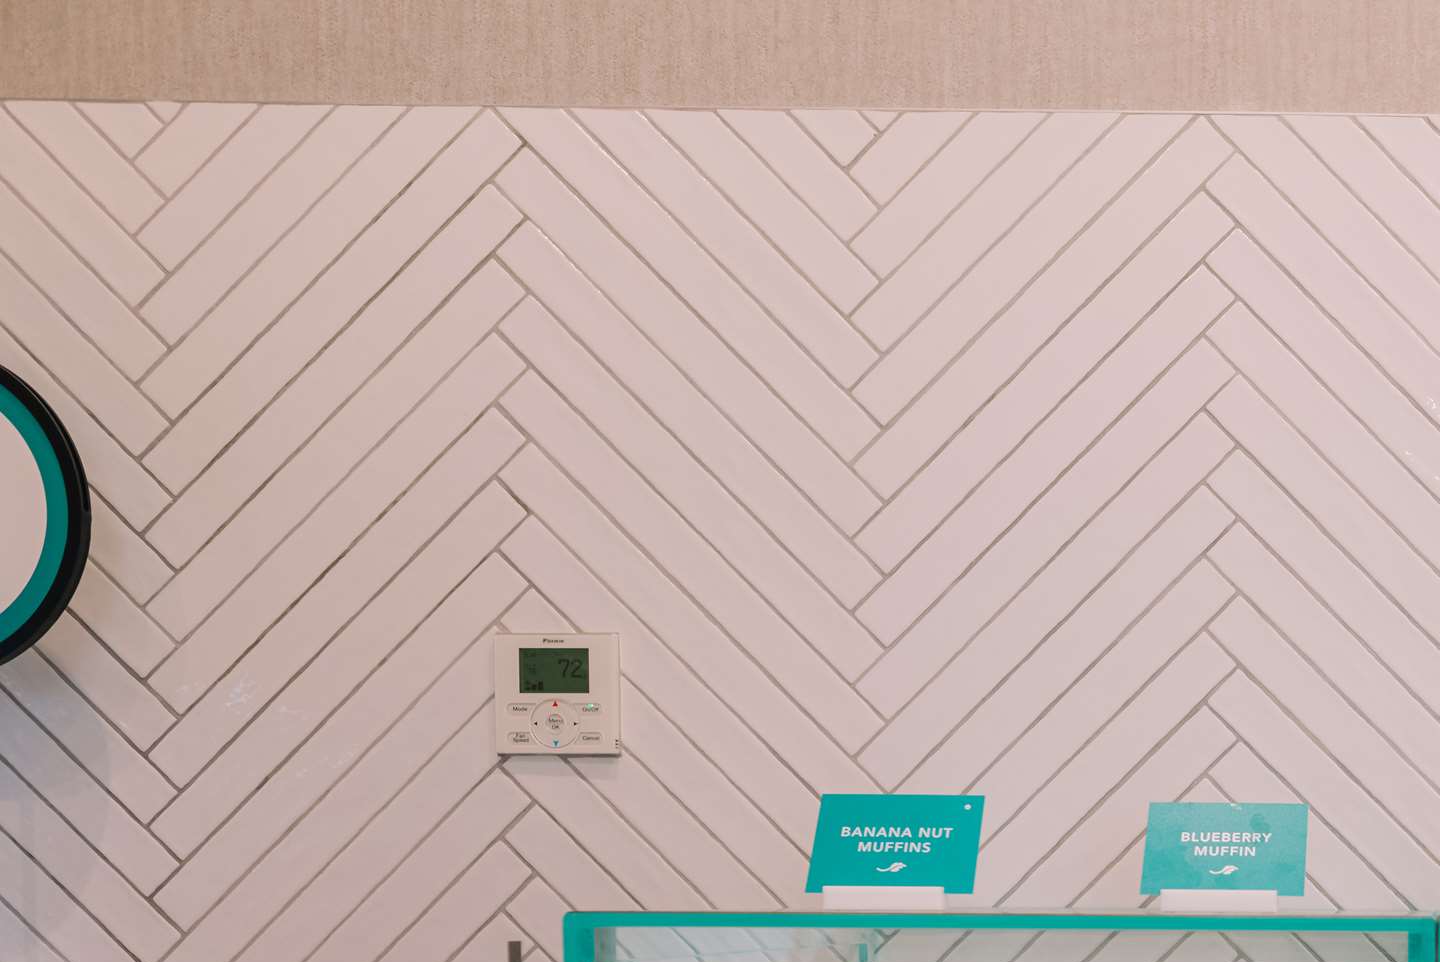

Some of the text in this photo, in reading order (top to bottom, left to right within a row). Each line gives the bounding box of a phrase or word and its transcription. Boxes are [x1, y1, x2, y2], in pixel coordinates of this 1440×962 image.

[557, 658, 583, 679] 72
[840, 826, 954, 839] BANANA NUT
[1180, 831, 1273, 843] BLUEBERRY
[857, 841, 931, 854] MUFFINS
[1193, 846, 1257, 857] MUFFIN
